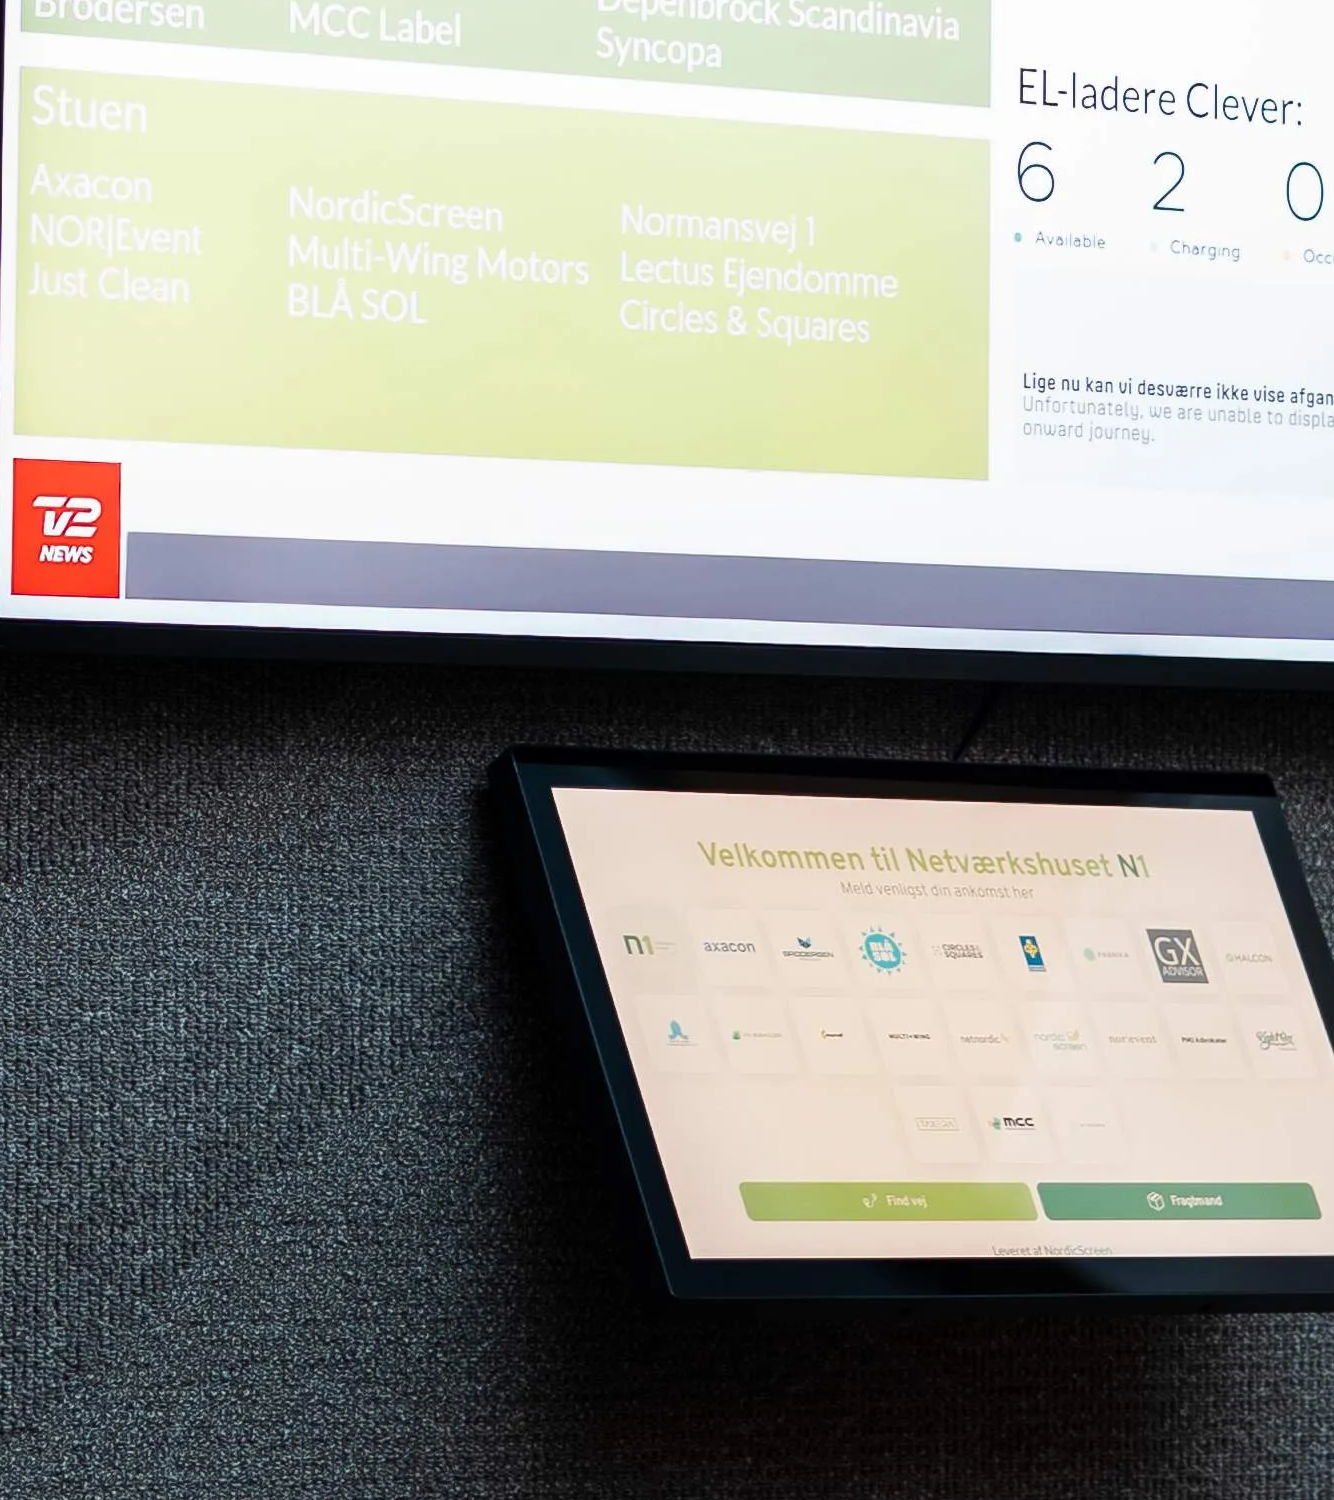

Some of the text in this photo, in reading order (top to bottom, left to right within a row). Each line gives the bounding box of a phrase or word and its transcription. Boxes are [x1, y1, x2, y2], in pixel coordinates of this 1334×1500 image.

[290, 1, 462, 48] MCC Label
[596, 26, 722, 73] Syncopa
[31, 84, 149, 134] Stuen
[1018, 68, 1302, 126] EL-ladere Clever:
[28, 163, 154, 204] Axacon
[1017, 141, 1054, 202] 6
[1152, 151, 1185, 212] 2
[1286, 161, 1324, 221] 0
[287, 186, 504, 233] NordicScreen
[621, 202, 816, 253] Normansvej 1
[287, 235, 589, 287] Multi-Wing Motors
[1035, 231, 1106, 250] Available
[1170, 240, 1241, 262] Charging
[26, 261, 190, 306] Just Clean
[620, 252, 899, 301] Lectus Ejendomme
[287, 276, 428, 325] BLÅ SOL
[620, 299, 870, 349] Circles & Squares
[1023, 373, 1056, 393] Lige
[1061, 377, 1081, 392] nu
[1085, 376, 1114, 394] kan
[1118, 378, 1132, 395] vi
[1138, 380, 1211, 400] desværre
[1216, 383, 1248, 401] ikke
[1254, 385, 1285, 403] vise
[1023, 396, 1144, 421] Unfortunately,
[1150, 405, 1172, 420] we
[1177, 406, 1203, 421] are
[1208, 406, 1261, 424] unable
[1267, 409, 1283, 425] to
[1023, 420, 1156, 444] onward journey.
[39, 545, 94, 564] NEWS
[697, 841, 1151, 879] Velkommen til Netværkshuset N1
[841, 881, 1034, 900] Meld venligst din ankomst her
[703, 940, 756, 954] axacon
[1154, 936, 1199, 966] GX
[1162, 965, 1203, 977] ADVISOR
